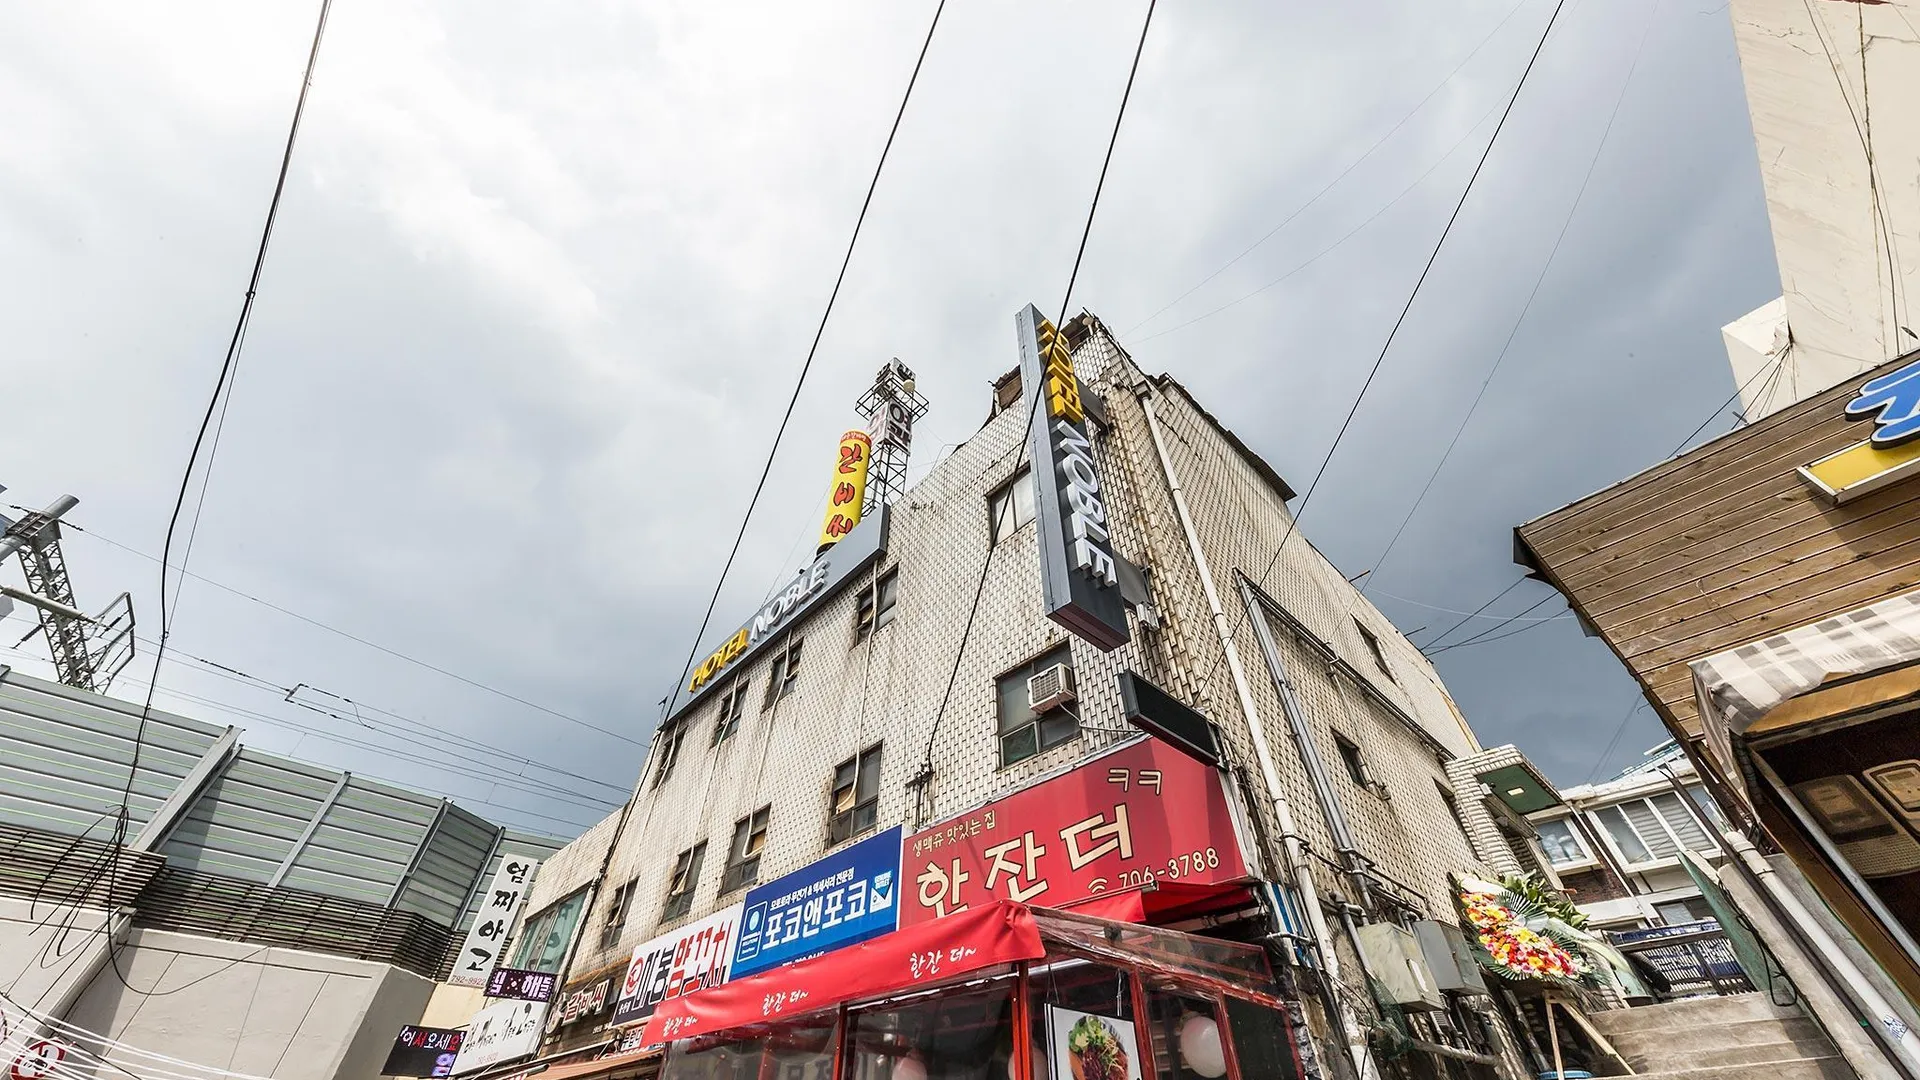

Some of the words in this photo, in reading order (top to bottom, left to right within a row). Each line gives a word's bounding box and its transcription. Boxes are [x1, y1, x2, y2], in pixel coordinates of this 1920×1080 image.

[1036, 318, 1084, 424] HOTEL
[889, 402, 913, 449] 여관
[1057, 420, 1118, 588] NOBLE
[688, 628, 749, 694] HOTEL
[749, 559, 831, 643] NOBLE
[947, 819, 982, 846] 맛있는
[984, 809, 996, 831] 집
[1118, 846, 1221, 888] 706-3788
[762, 879, 868, 951] 포코앤포코
[909, 949, 944, 980] 한잔
[762, 992, 787, 1017] 한잔
